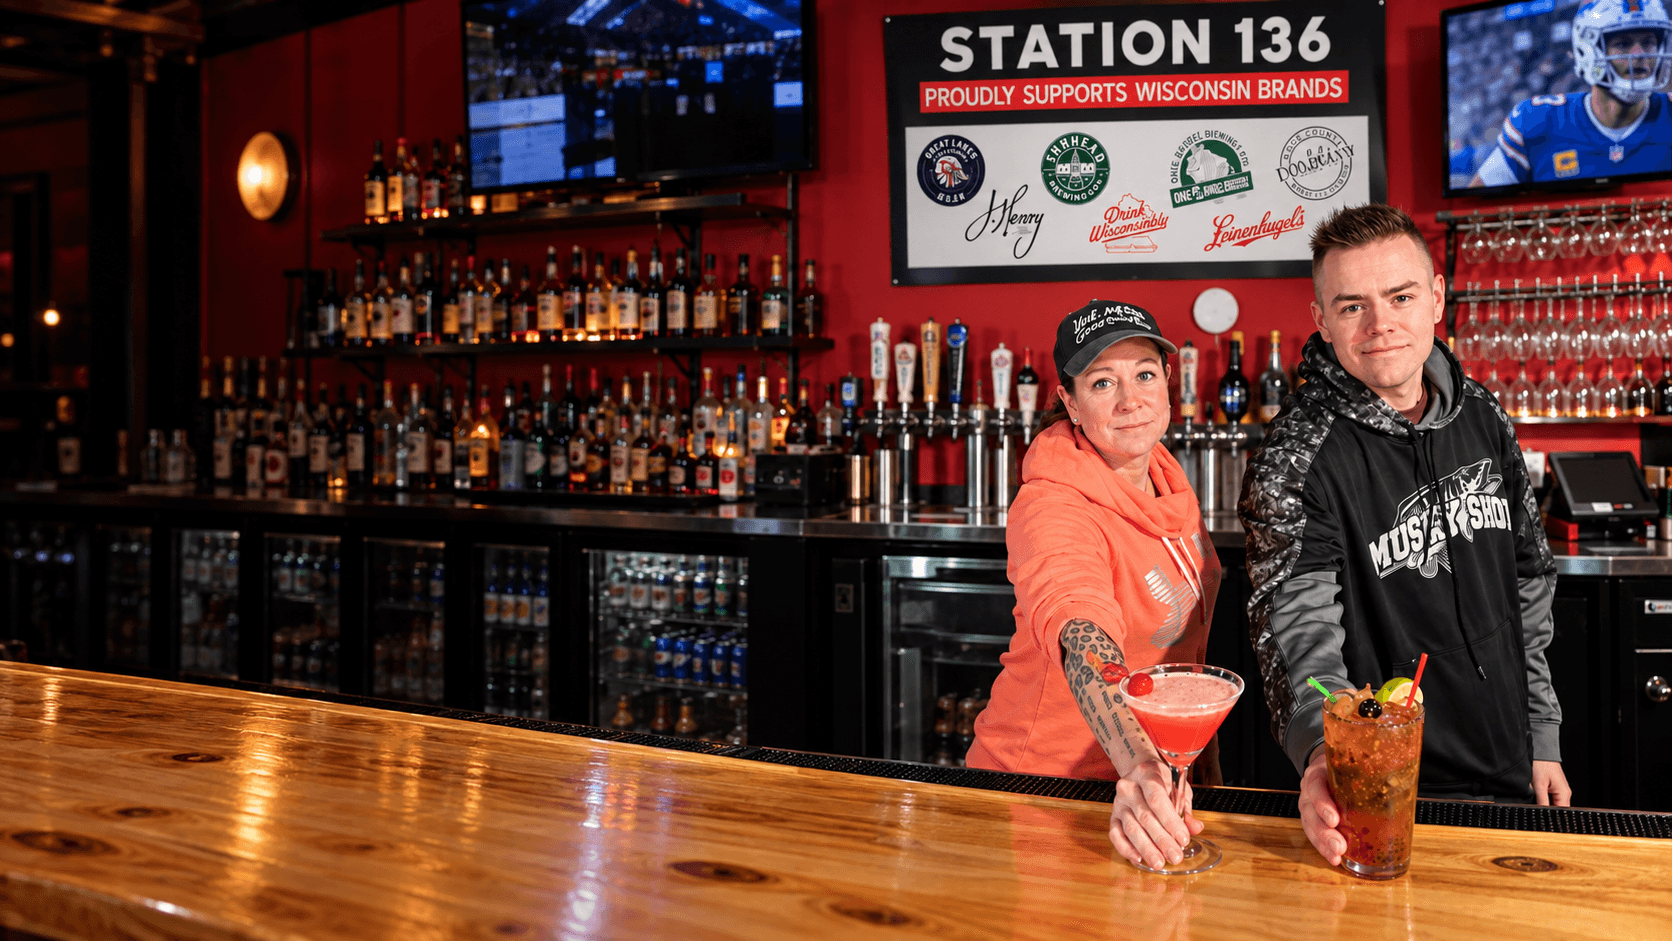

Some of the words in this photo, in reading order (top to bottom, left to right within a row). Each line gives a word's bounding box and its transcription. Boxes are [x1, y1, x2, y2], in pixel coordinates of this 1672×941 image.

[940, 19, 1210, 73] STATION
[1234, 16, 1331, 64] 136
[924, 85, 1015, 107] PROUDLY
[1023, 82, 1127, 105] SUPPORTS
[1135, 79, 1251, 102] WISCONSIN
[1258, 77, 1343, 99] BRANDS
[1089, 211, 1170, 243] Wisconsinbly
[1104, 200, 1146, 225] Drink
